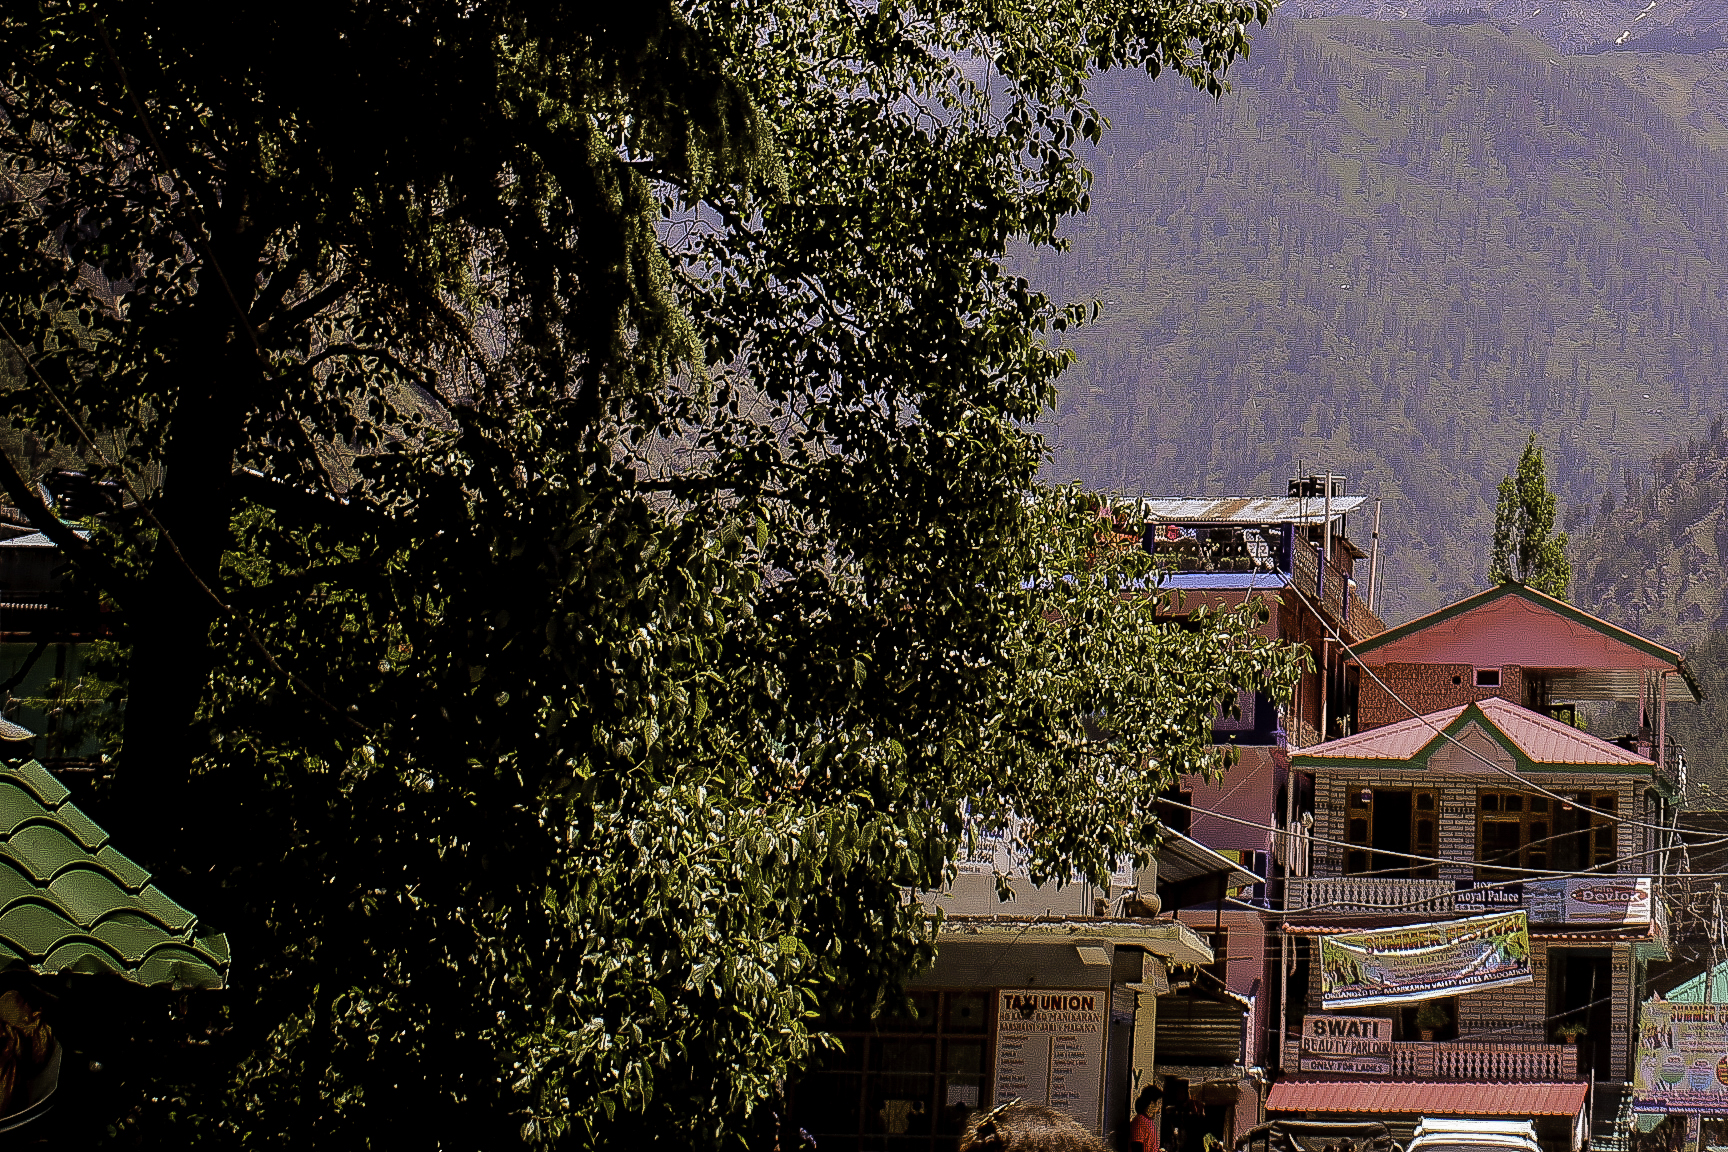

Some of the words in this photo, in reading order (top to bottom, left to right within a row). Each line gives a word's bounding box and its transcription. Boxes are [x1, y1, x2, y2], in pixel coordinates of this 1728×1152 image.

[1457, 890, 1486, 904] Royal
[1487, 890, 1519, 902] Palace
[1432, 979, 1457, 989] VALLEY
[1459, 976, 1482, 986] HOTEL
[1004, 994, 1039, 1010] TAXI
[1041, 995, 1095, 1010] UNION
[1670, 1005, 1716, 1022] SUMMER
[1313, 1019, 1379, 1038] SWATI
[1304, 1038, 1348, 1054] BEAUTY
[1311, 1061, 1334, 1070] ONLY
[1337, 1062, 1353, 1071] FOR
[1356, 1063, 1383, 1073] LADIES
